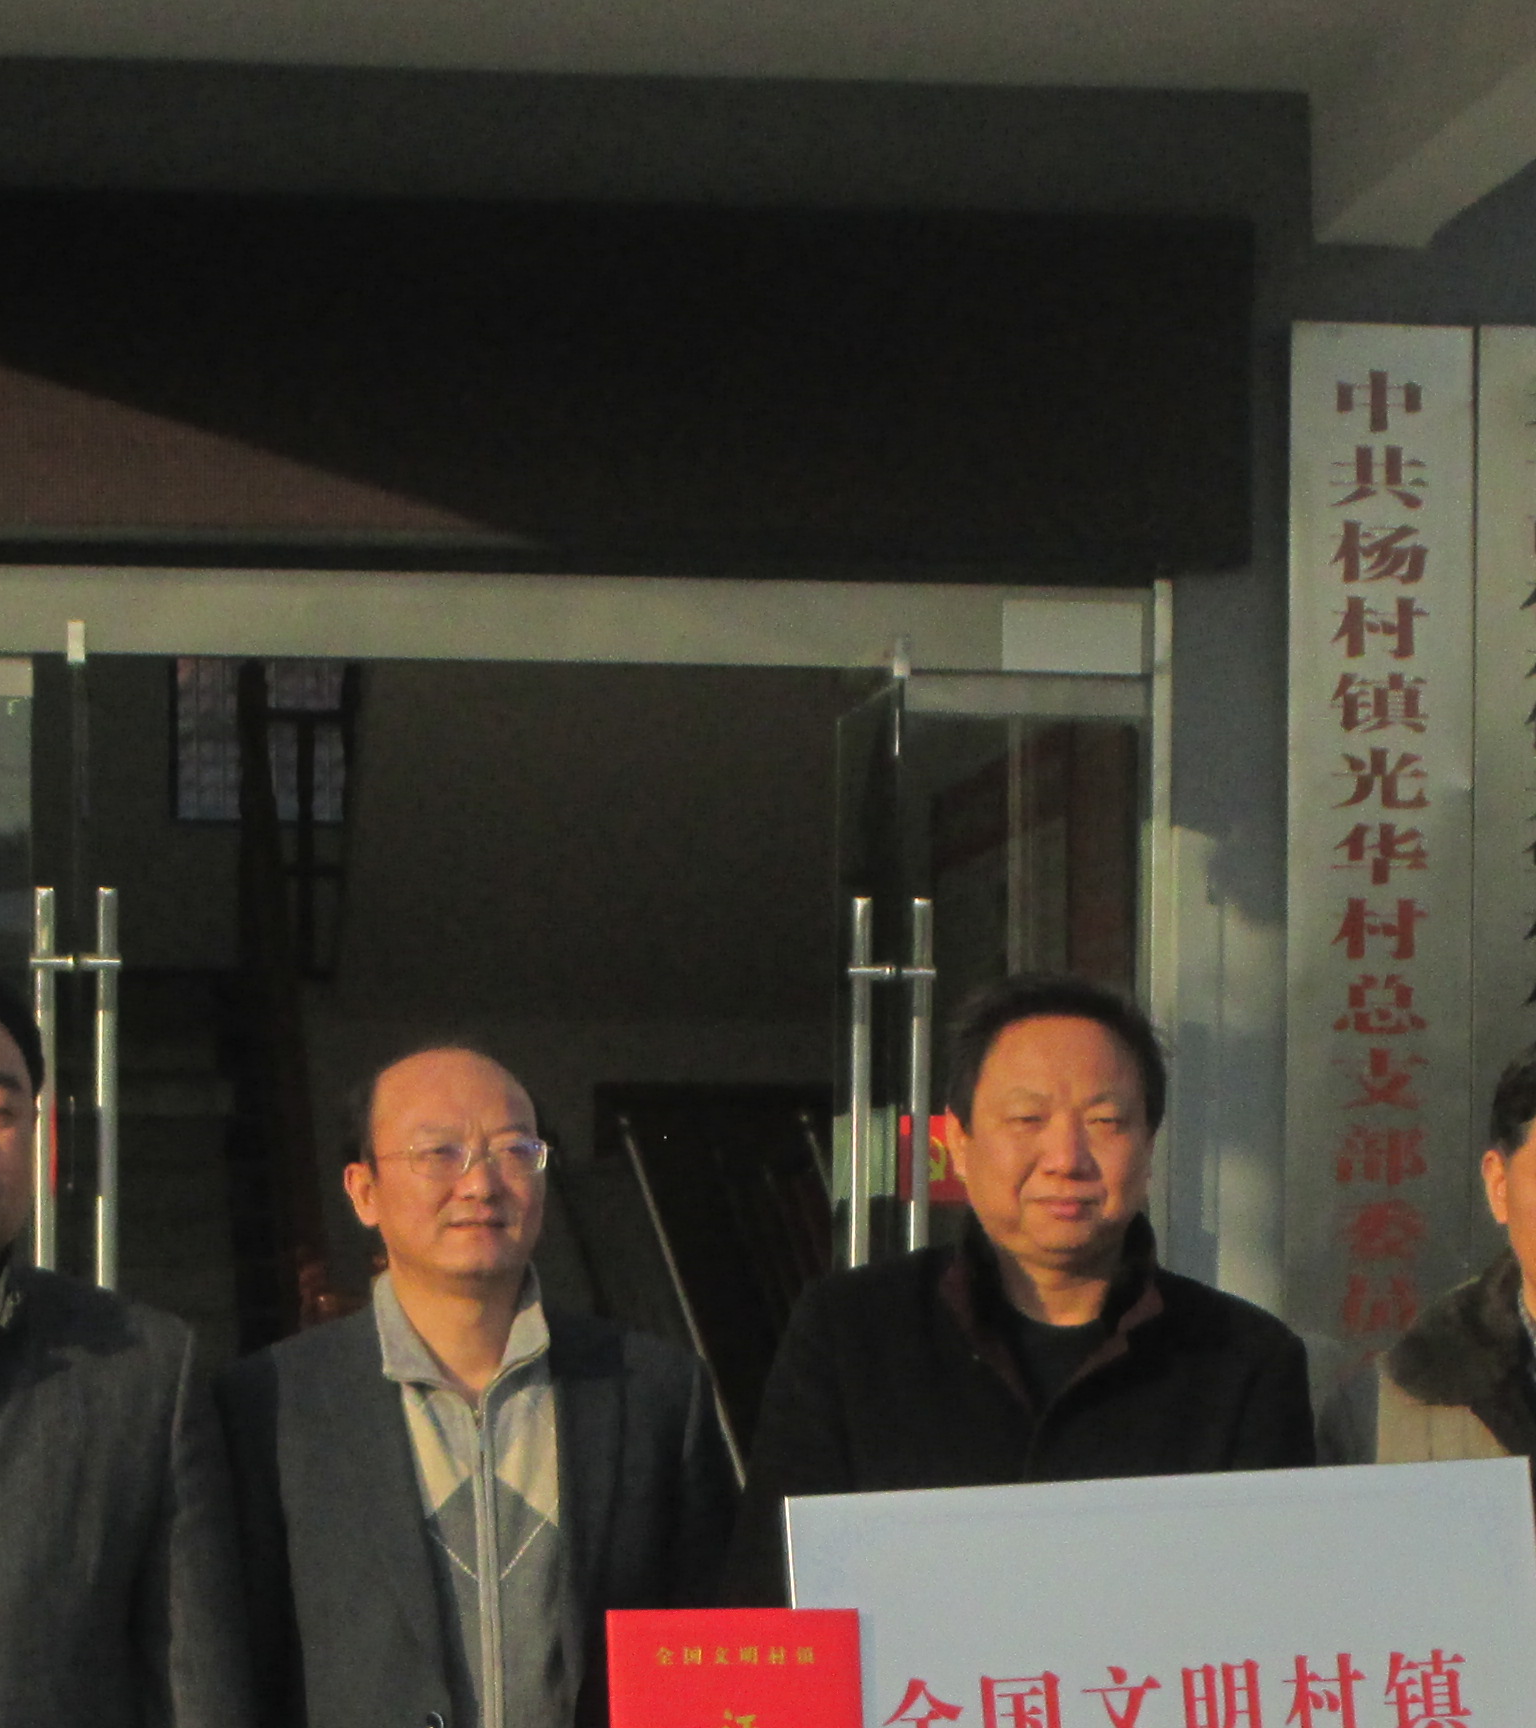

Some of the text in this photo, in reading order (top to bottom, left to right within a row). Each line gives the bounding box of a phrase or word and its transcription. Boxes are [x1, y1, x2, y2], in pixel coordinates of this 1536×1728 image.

[1330, 369, 1430, 1382] 中共杨村镇光华村总支部委员
[656, 1646, 815, 1665] 全国文明村镇
